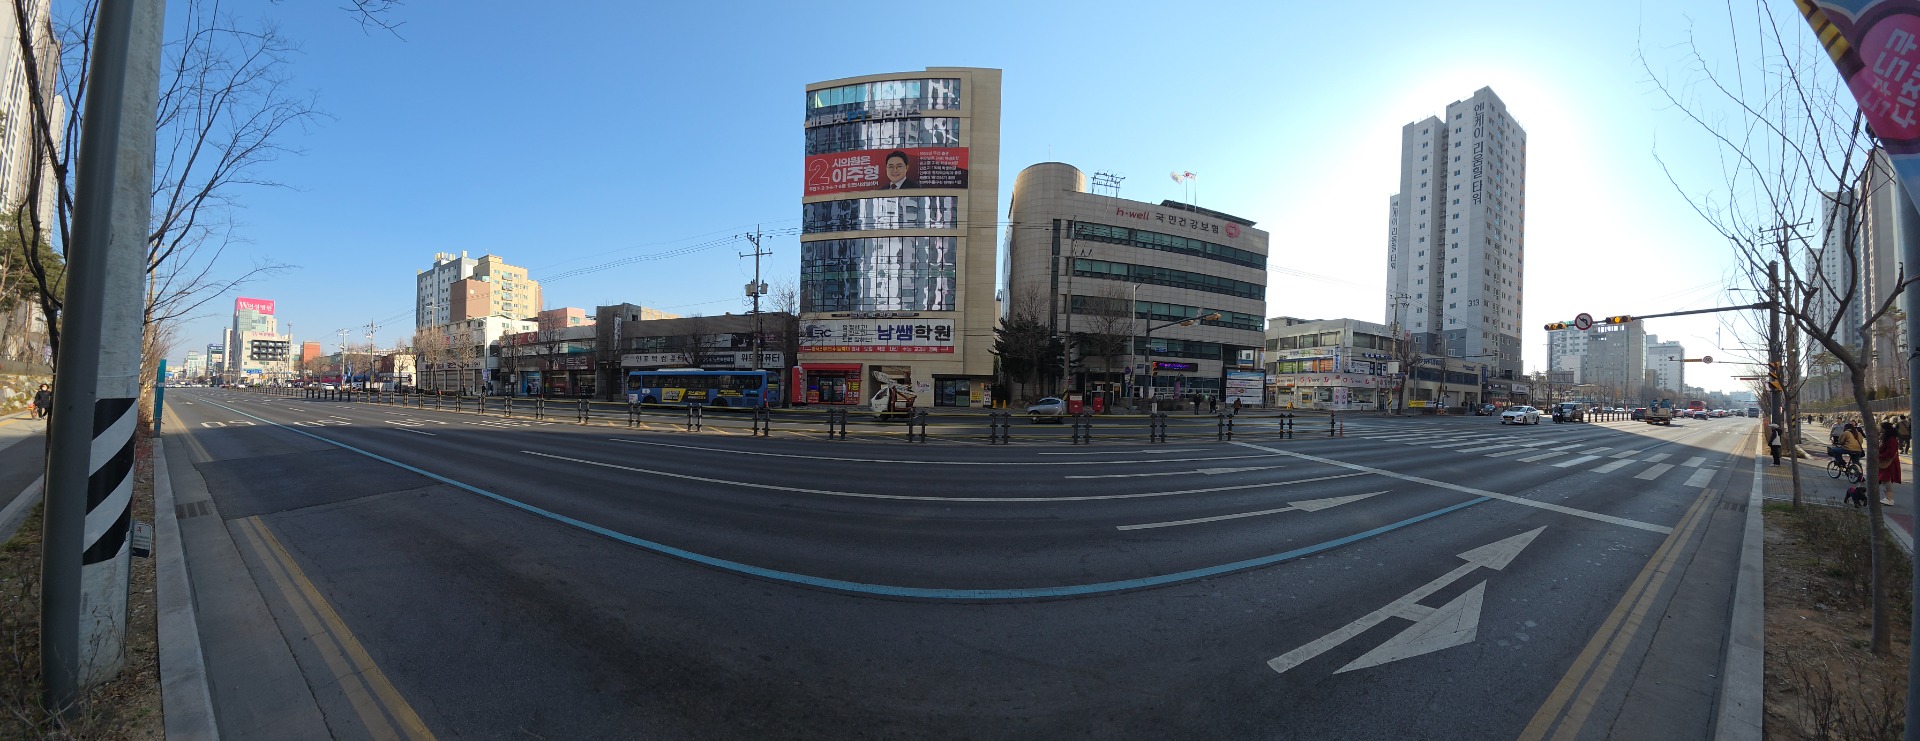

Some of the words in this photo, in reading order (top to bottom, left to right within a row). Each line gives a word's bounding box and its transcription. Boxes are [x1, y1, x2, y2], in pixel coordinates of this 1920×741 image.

[832, 155, 871, 168] 시의원은
[808, 158, 830, 186] 2
[832, 165, 879, 183] 이주형
[1155, 212, 1219, 234] 국민건강보험
[1468, 299, 1480, 307] 313
[877, 324, 951, 342] 남쌤학원
